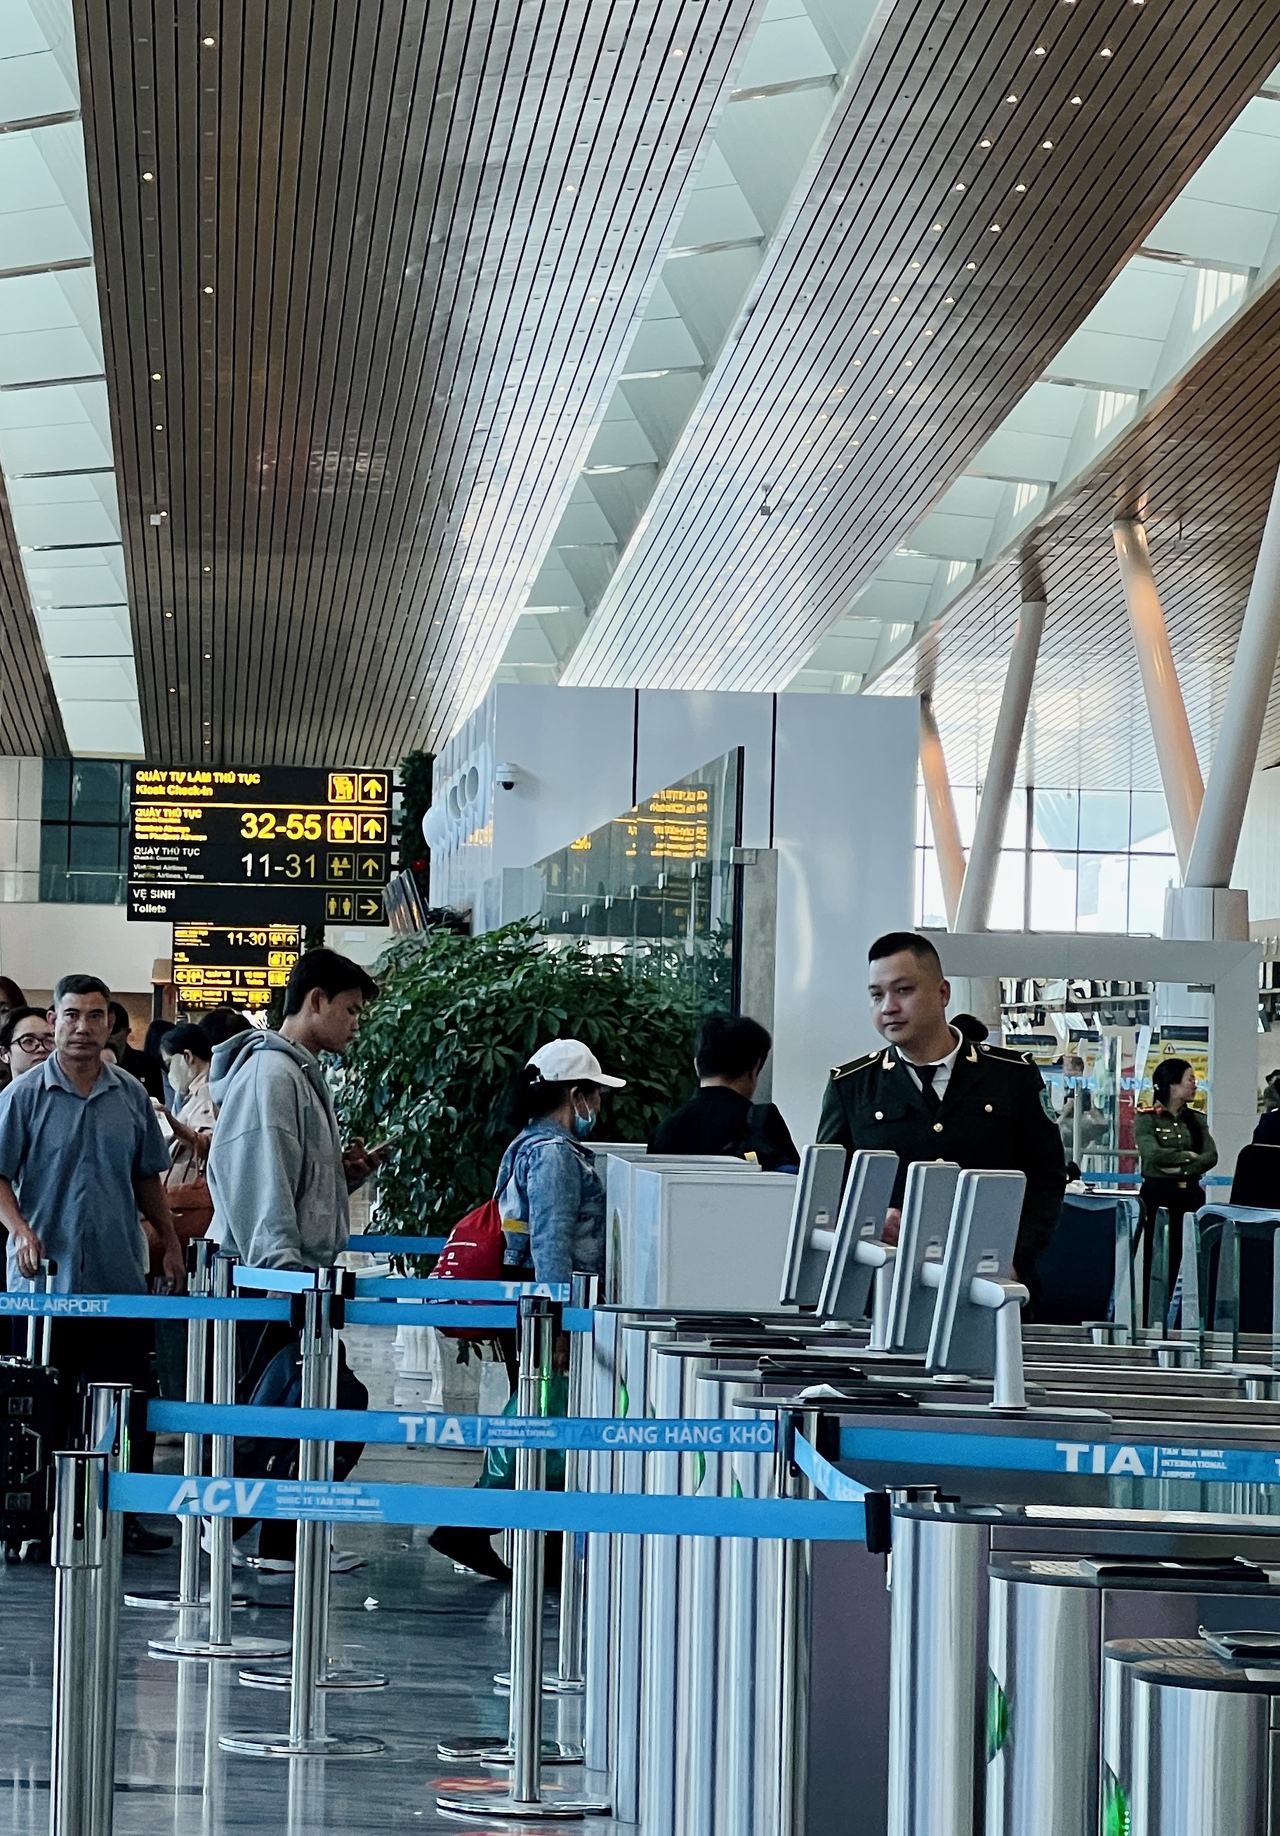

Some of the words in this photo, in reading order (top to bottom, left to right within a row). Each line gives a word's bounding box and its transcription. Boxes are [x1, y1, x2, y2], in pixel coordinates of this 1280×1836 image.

[136, 785, 165, 795] Kiosk
[167, 785, 213, 796] Check-in
[240, 812, 322, 841] 32-55
[241, 852, 316, 879] 11-31
[133, 889, 147, 900] VỆ
[150, 890, 176, 900] SINH
[133, 903, 167, 914] Toilets
[227, 931, 267, 946] 11-30
[500, 1281, 554, 1301] TIA
[43, 1298, 110, 1314] AIRPORT
[398, 1416, 466, 1445] TIA
[664, 1422, 722, 1444] HÀNG
[729, 1422, 775, 1444] KHÔ
[1056, 1442, 1147, 1476] TIA
[1161, 1459, 1227, 1469] INTERNATIONAL
[168, 1479, 266, 1515] ACV
